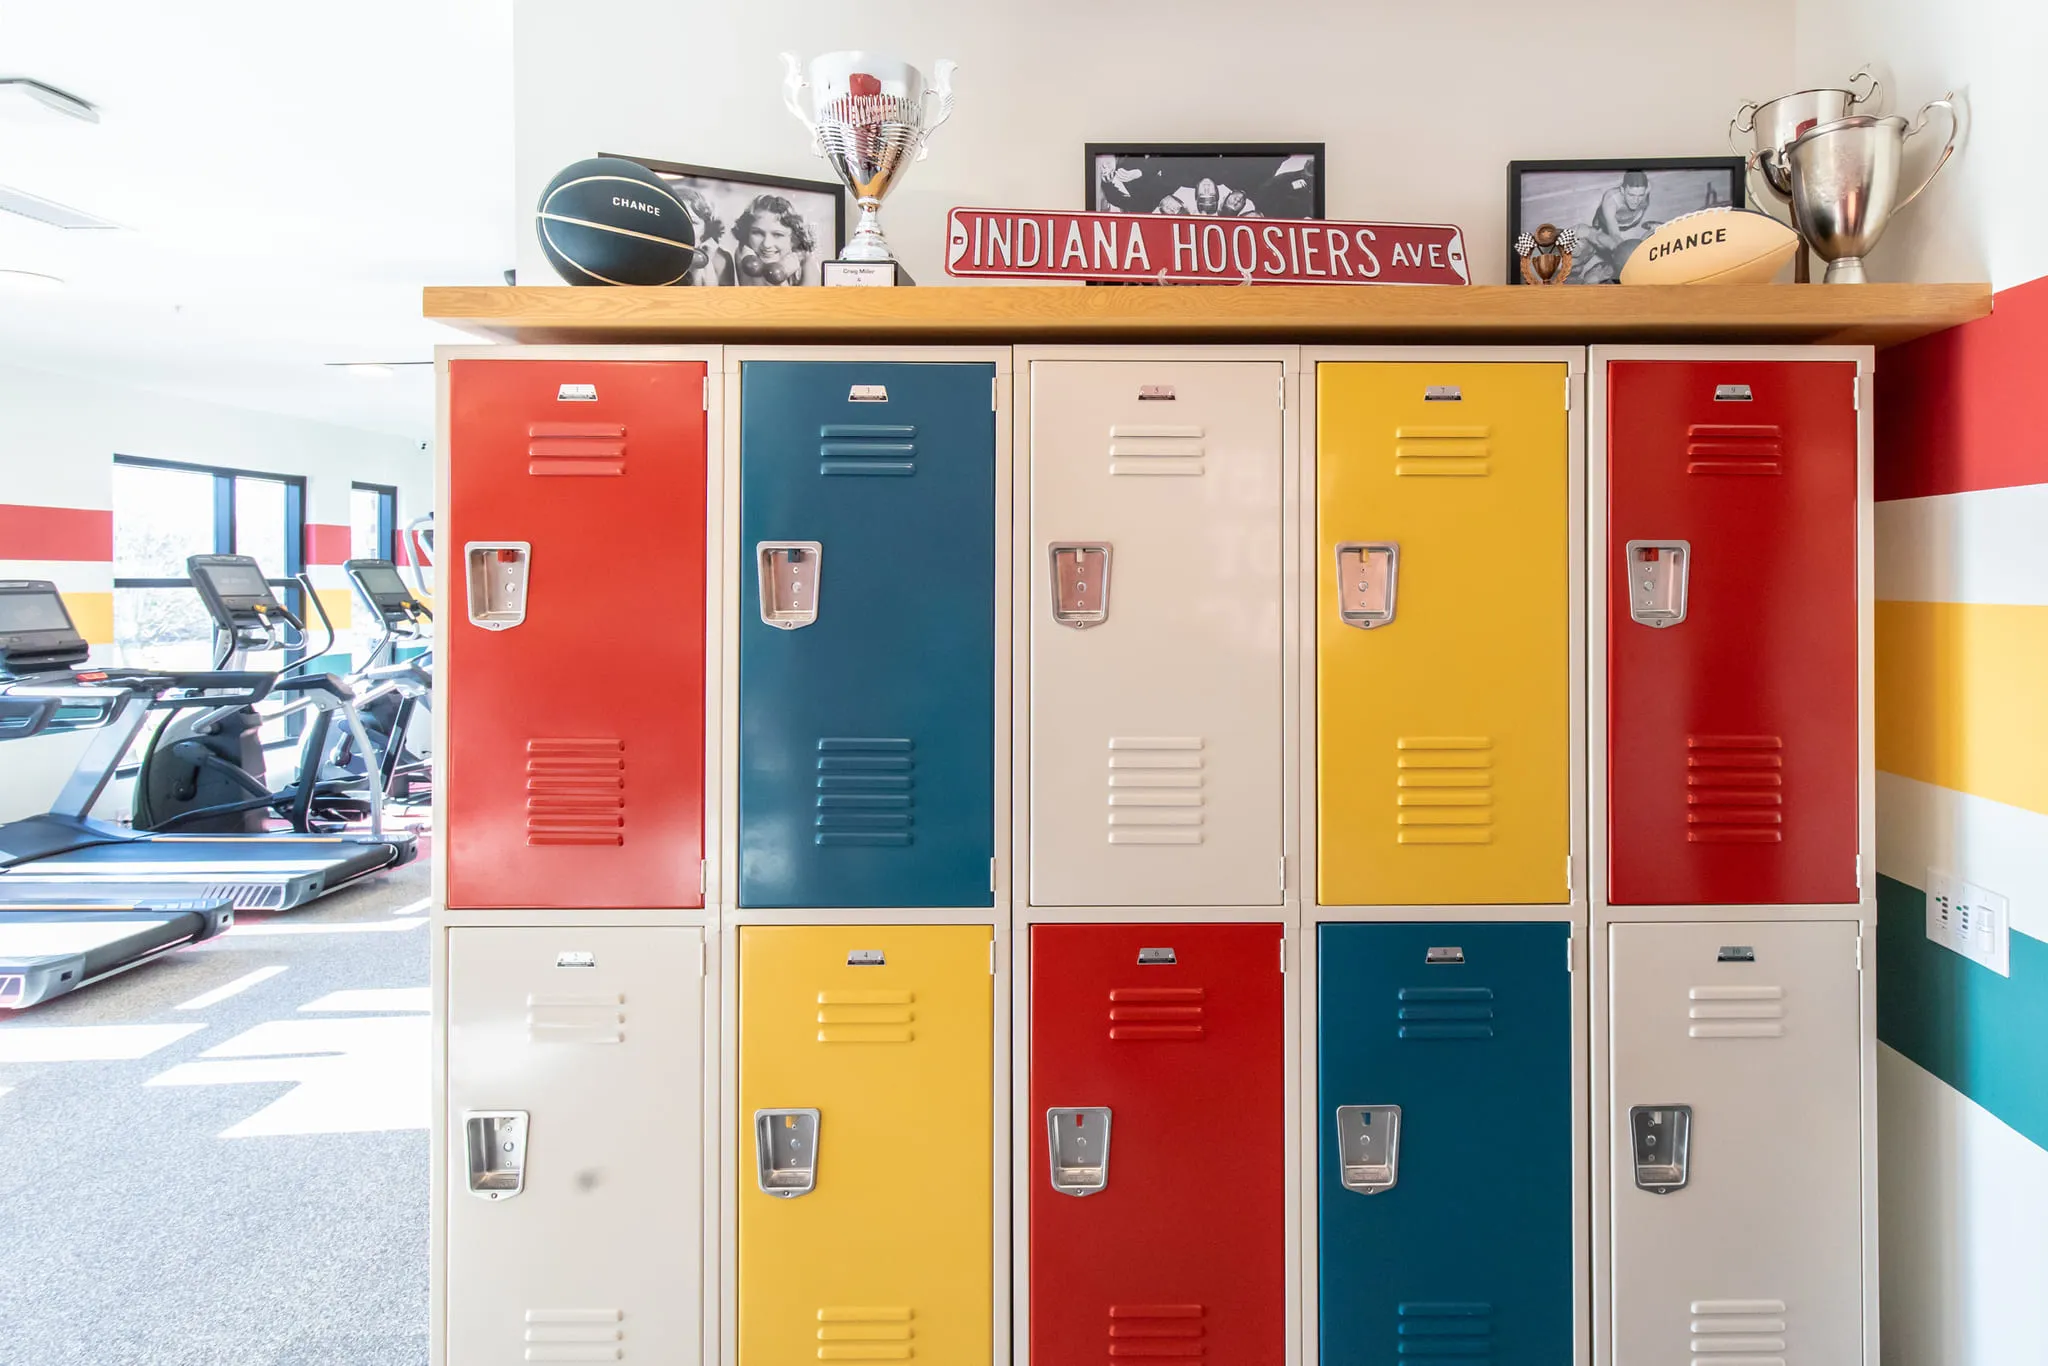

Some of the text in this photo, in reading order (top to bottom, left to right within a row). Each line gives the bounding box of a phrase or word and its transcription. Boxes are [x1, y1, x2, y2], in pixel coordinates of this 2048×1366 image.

[612, 196, 661, 217] CHANCE
[973, 216, 1446, 278] INDIANA HOOSIERS AVE
[1649, 228, 1727, 261] CHANCE
